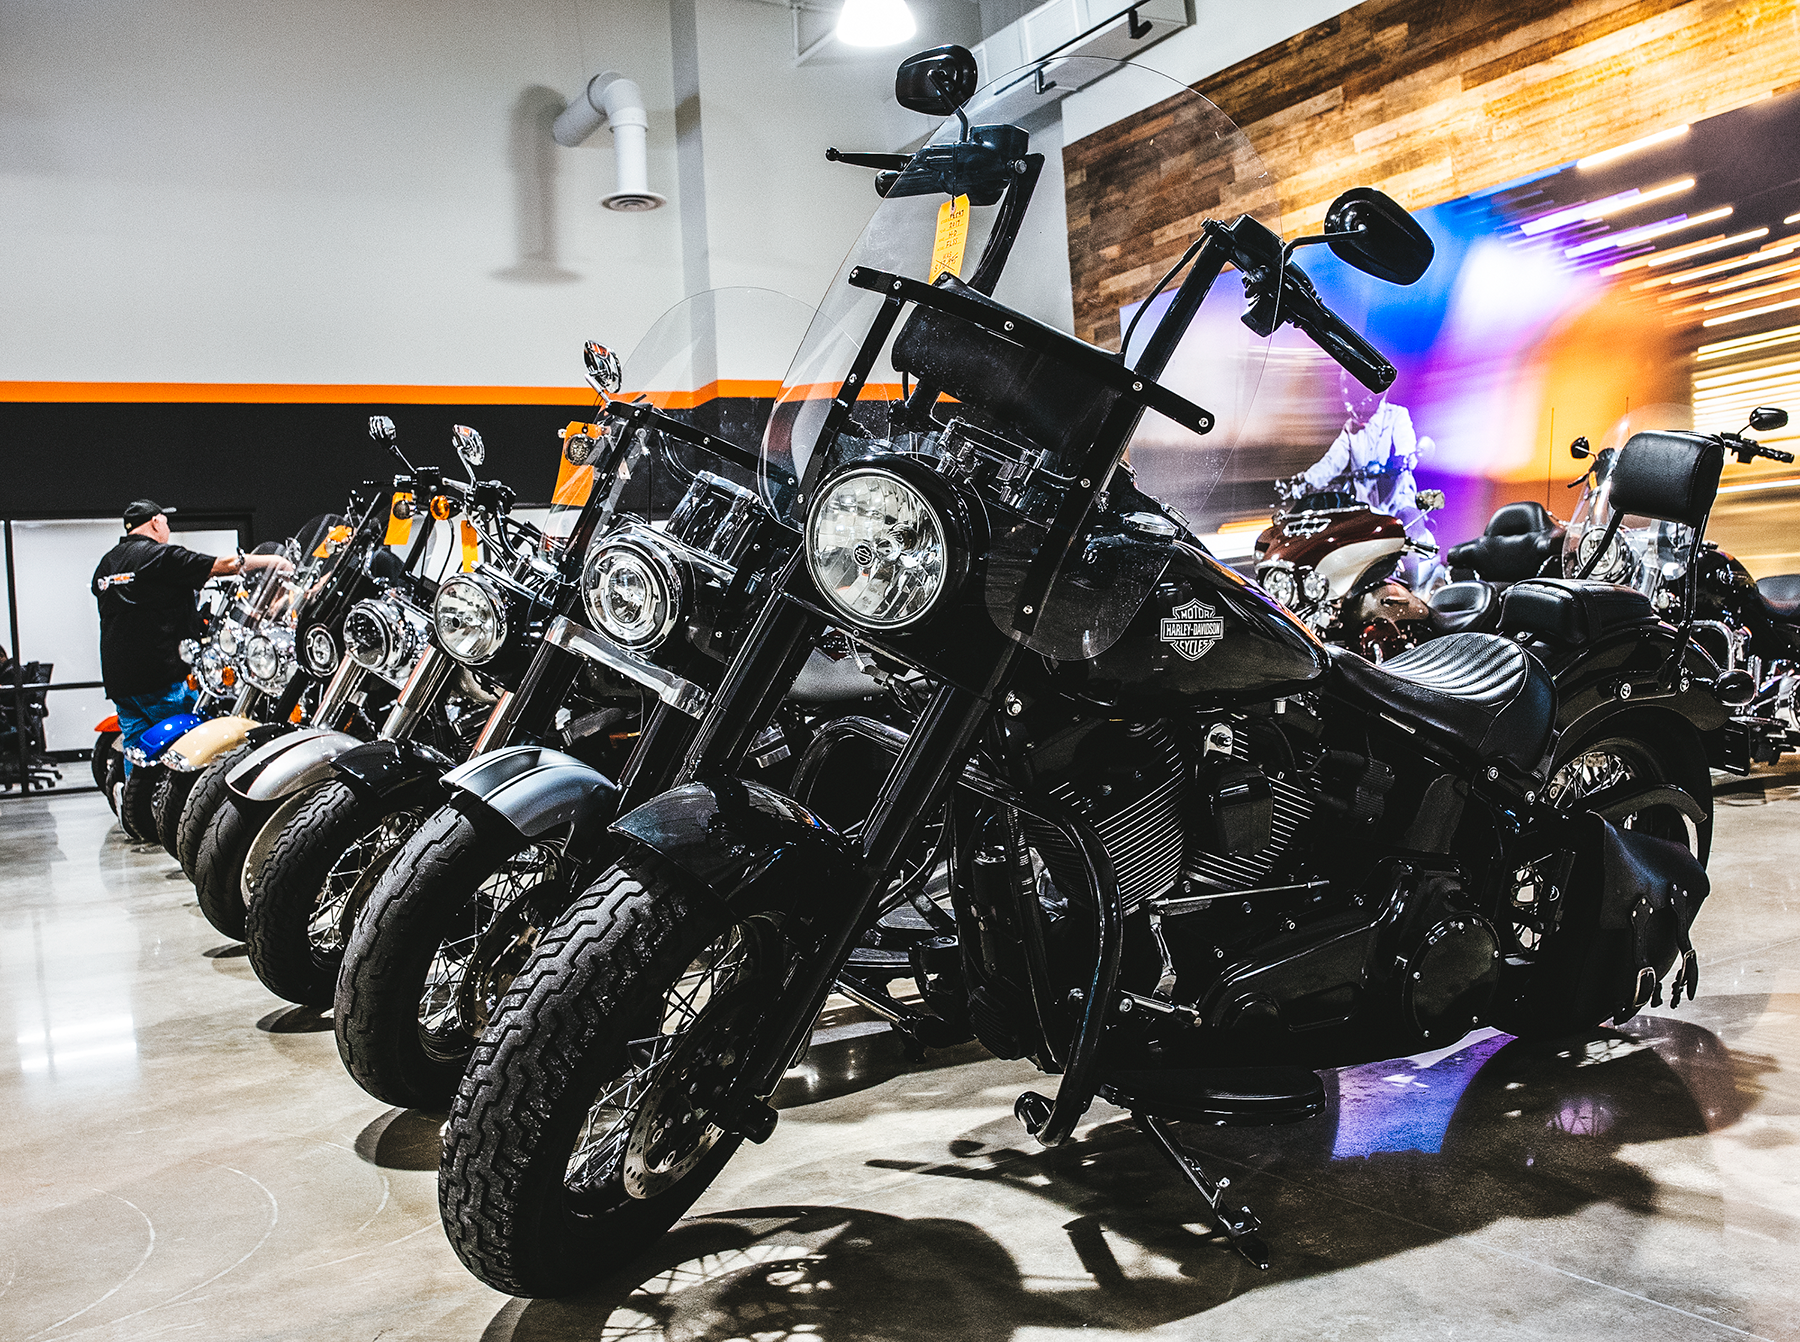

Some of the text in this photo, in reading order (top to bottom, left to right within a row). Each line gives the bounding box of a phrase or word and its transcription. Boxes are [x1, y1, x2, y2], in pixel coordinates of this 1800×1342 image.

[1180, 604, 1210, 619] MOTOR
[1166, 622, 1220, 636] HARLEY-DAVIDSON
[1179, 639, 1209, 655] CYCLES
